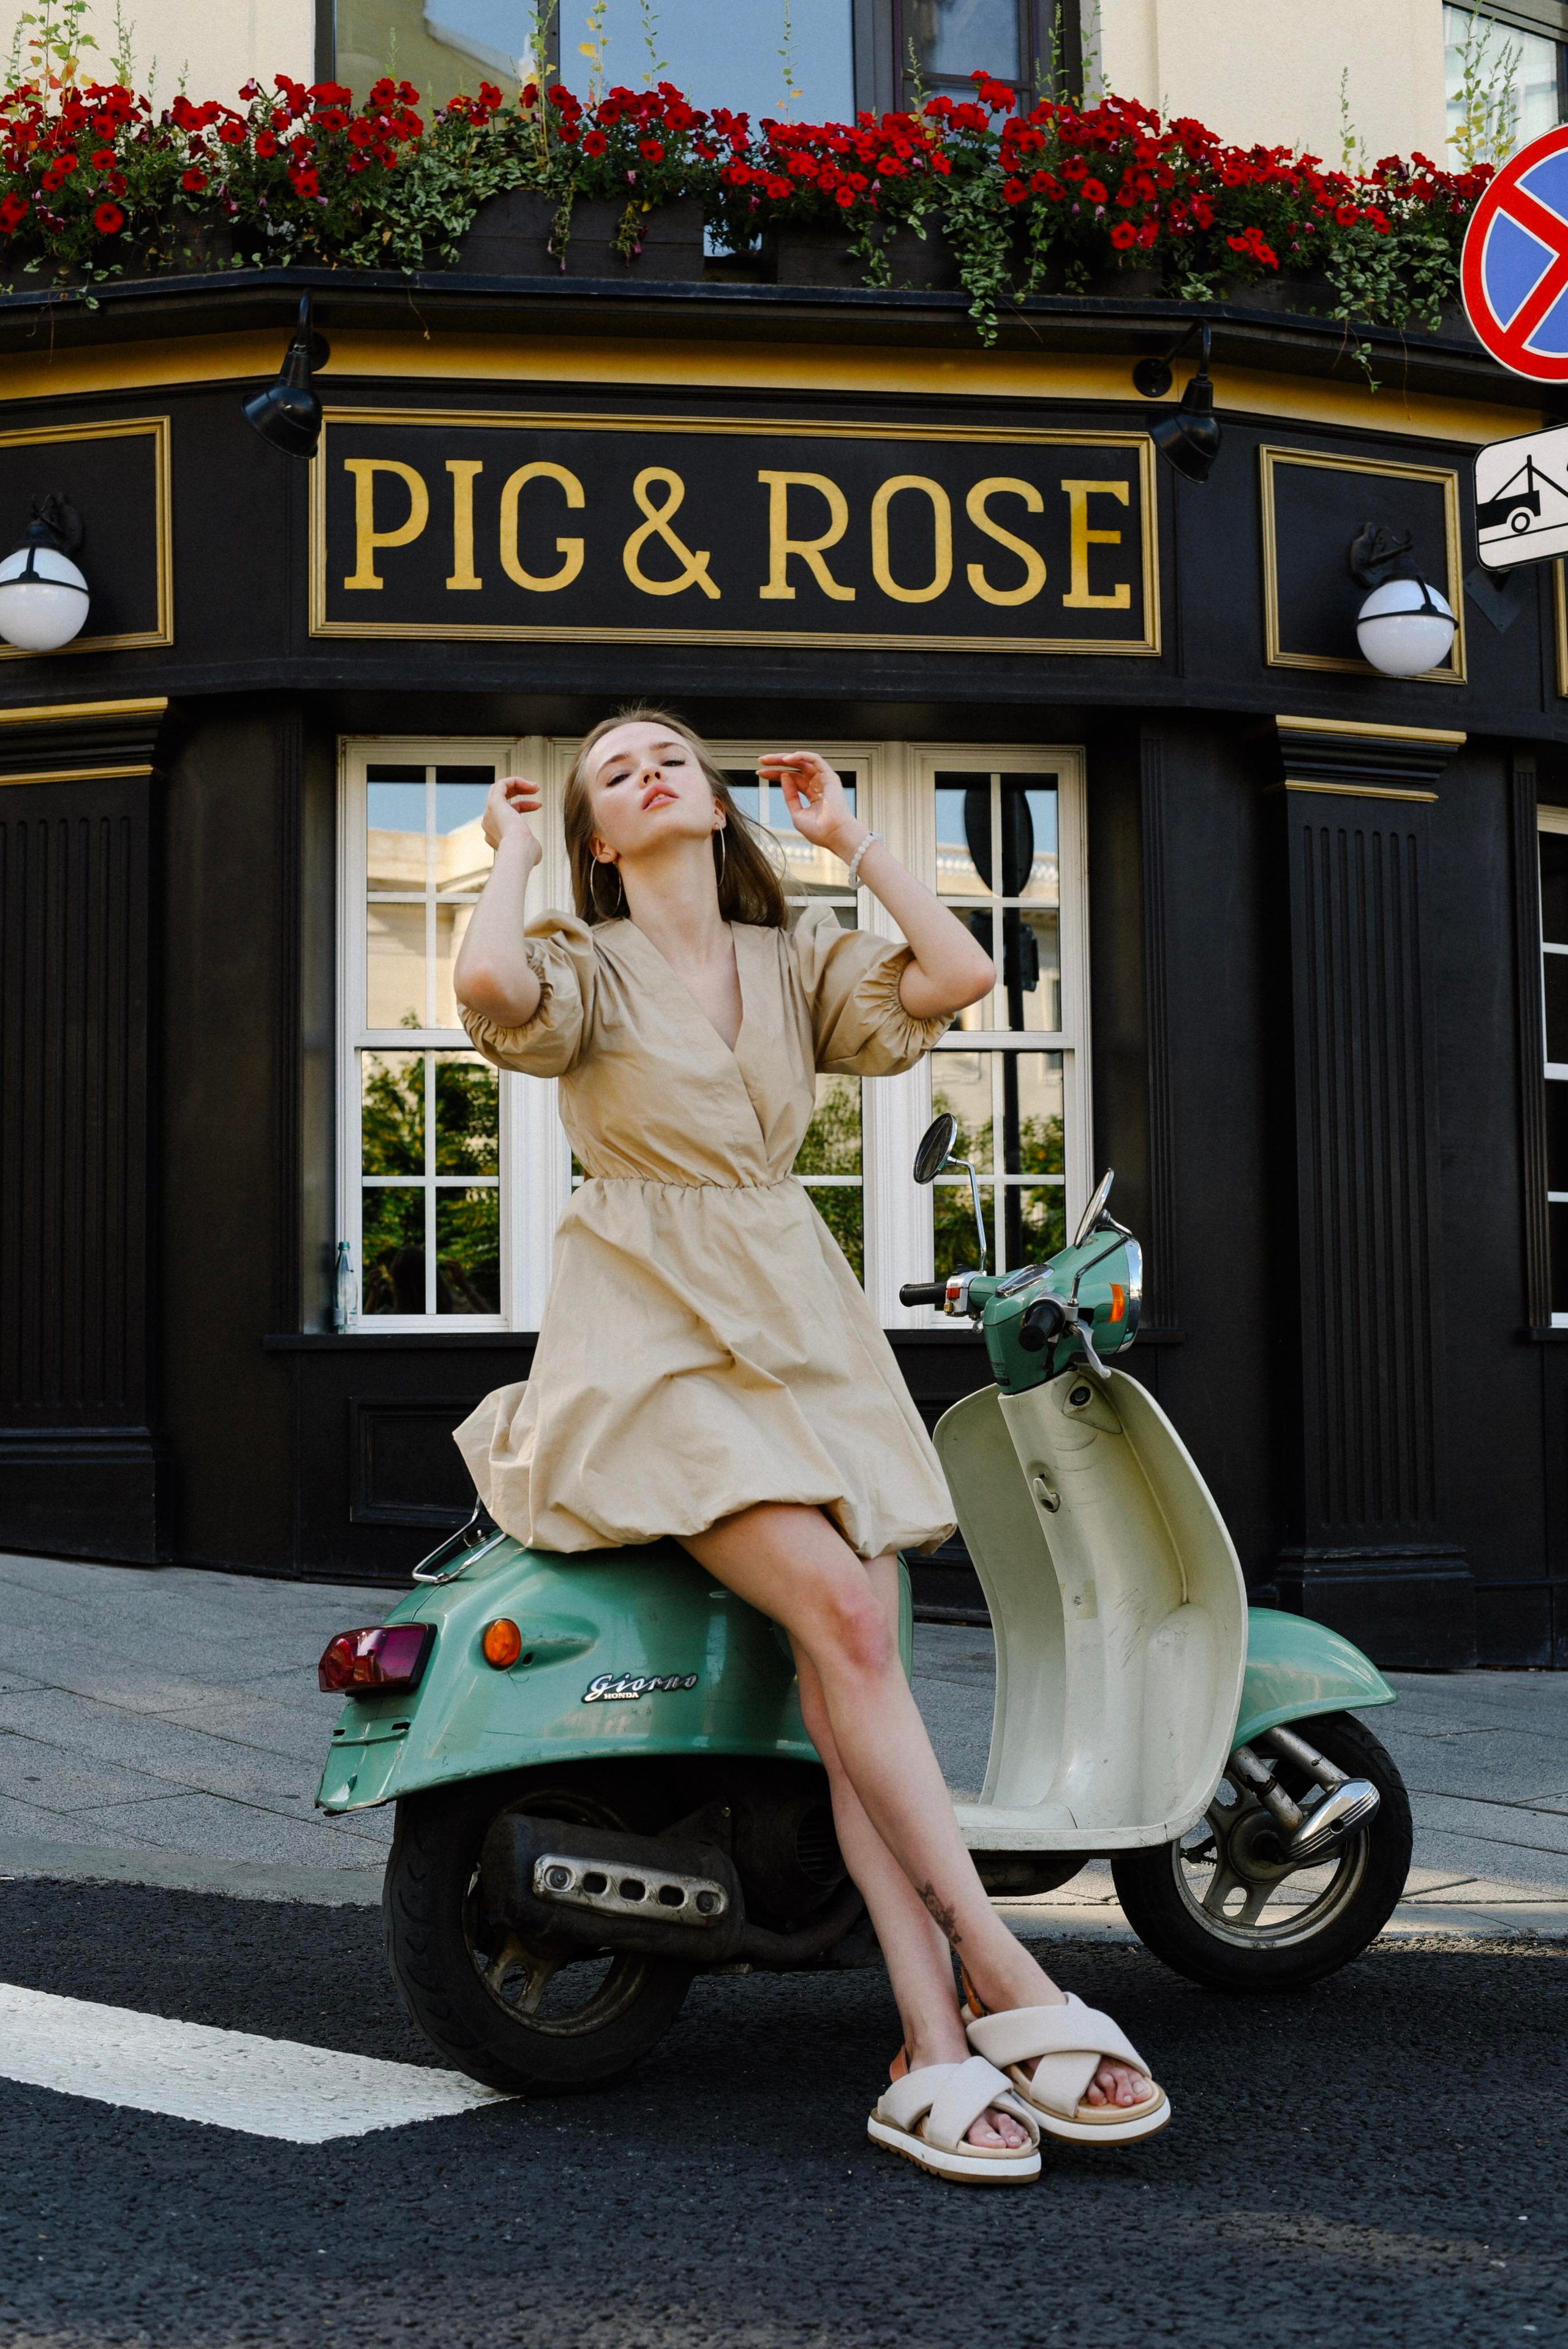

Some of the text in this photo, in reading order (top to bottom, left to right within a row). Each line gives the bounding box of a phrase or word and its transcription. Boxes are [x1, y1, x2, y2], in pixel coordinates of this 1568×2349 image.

[344, 458, 1131, 609] PIG & ROSE
[584, 1673, 697, 1702] Giorno
